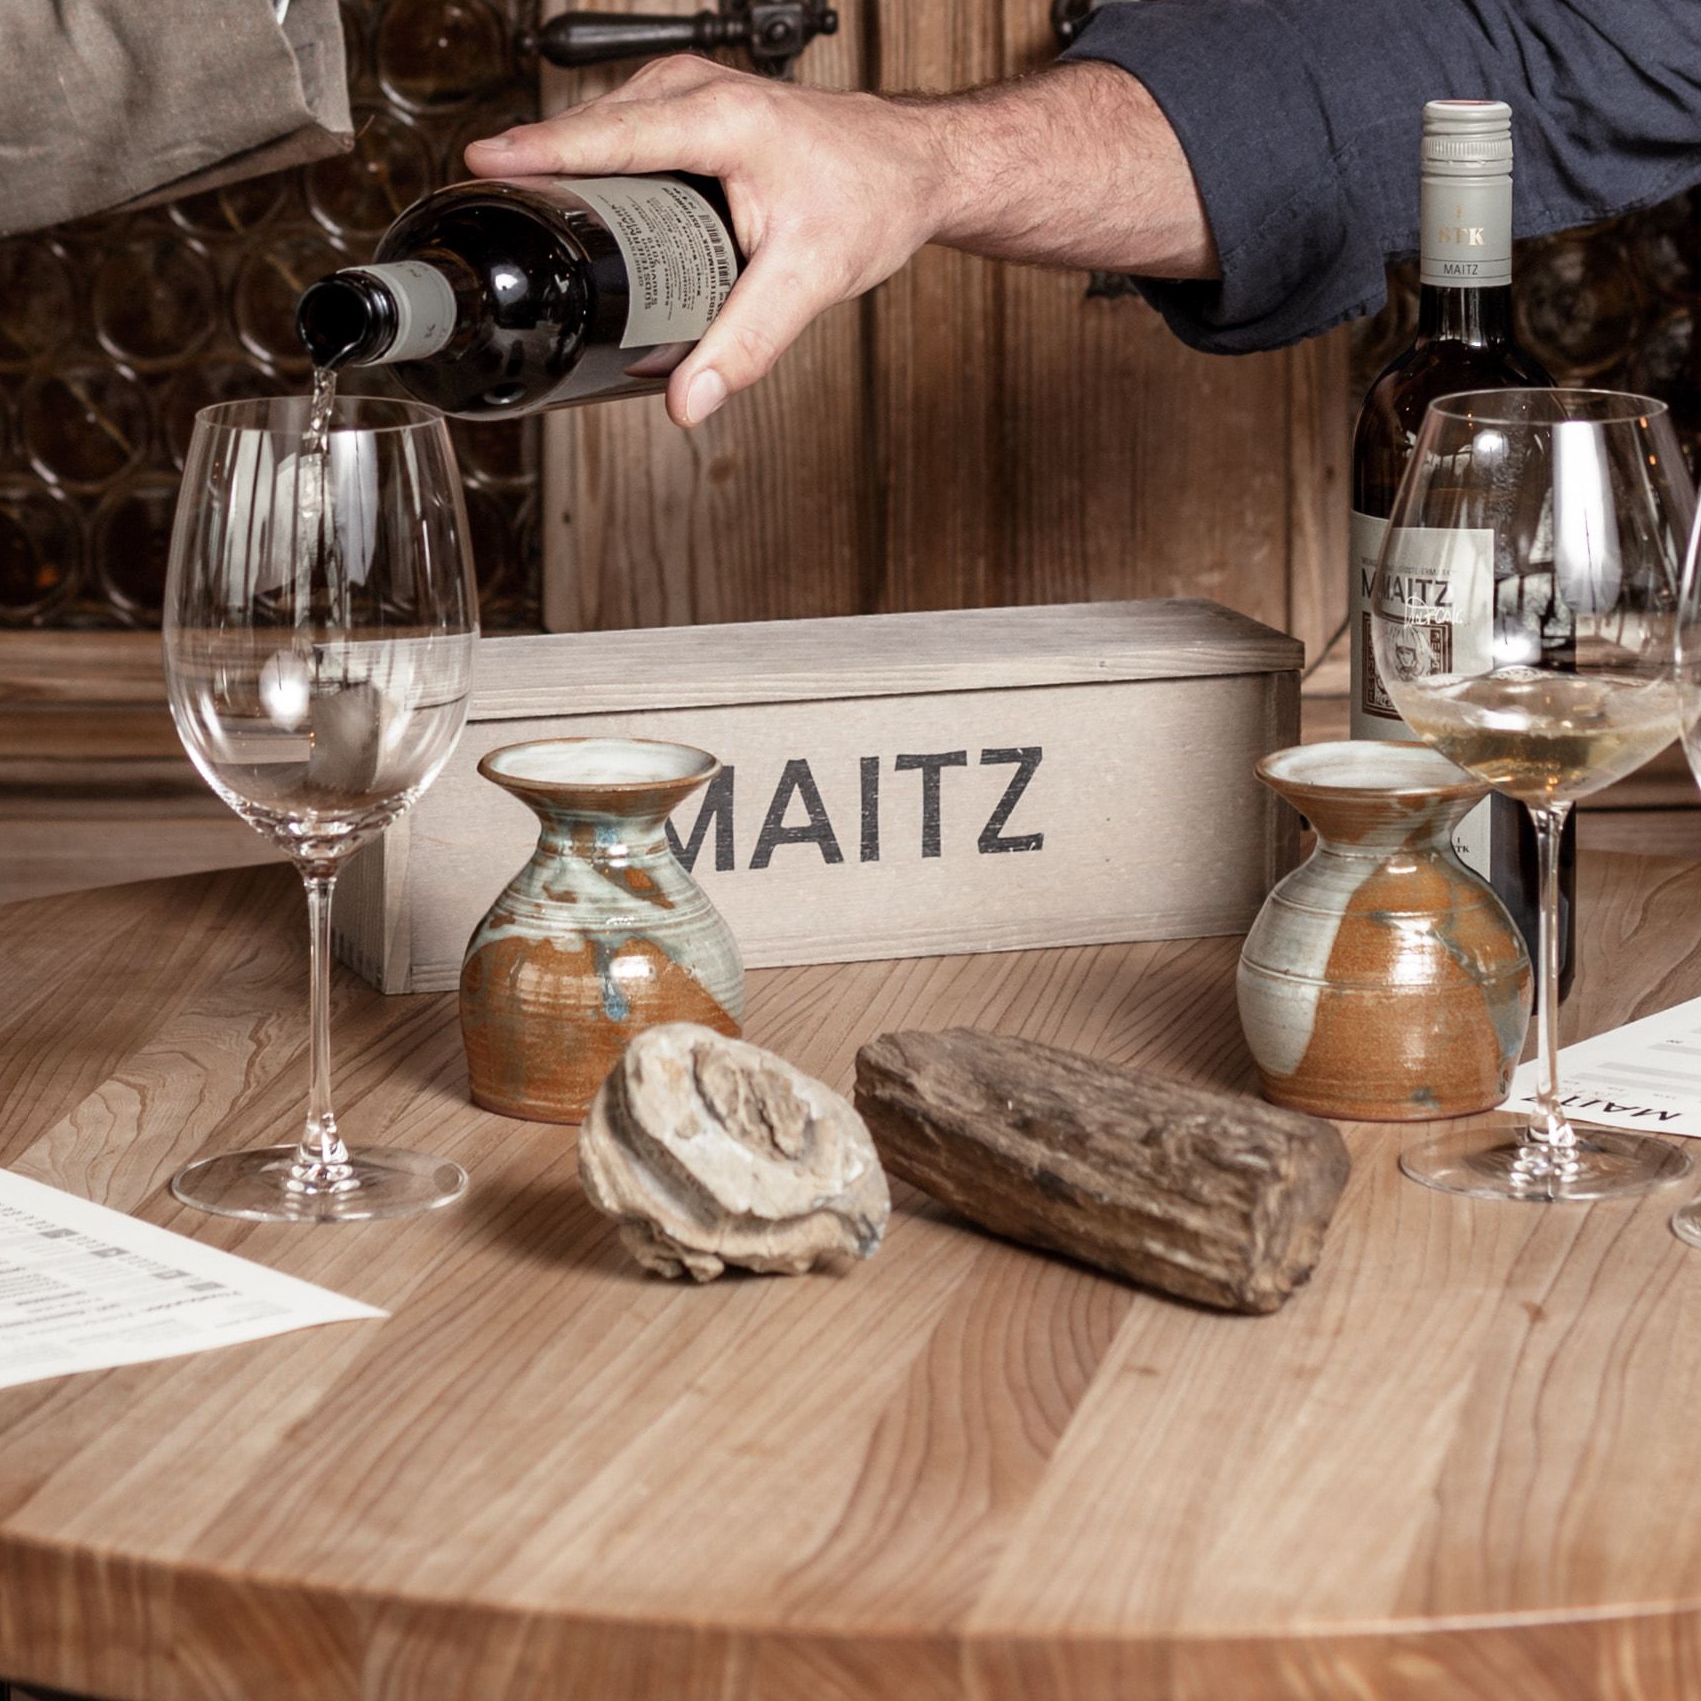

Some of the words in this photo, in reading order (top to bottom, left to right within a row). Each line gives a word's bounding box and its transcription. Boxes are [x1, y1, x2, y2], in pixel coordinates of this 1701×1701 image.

[642, 237, 659, 306] Sauvignon
[1443, 263, 1478, 276] MAITZ
[1456, 845, 1469, 853] TK
